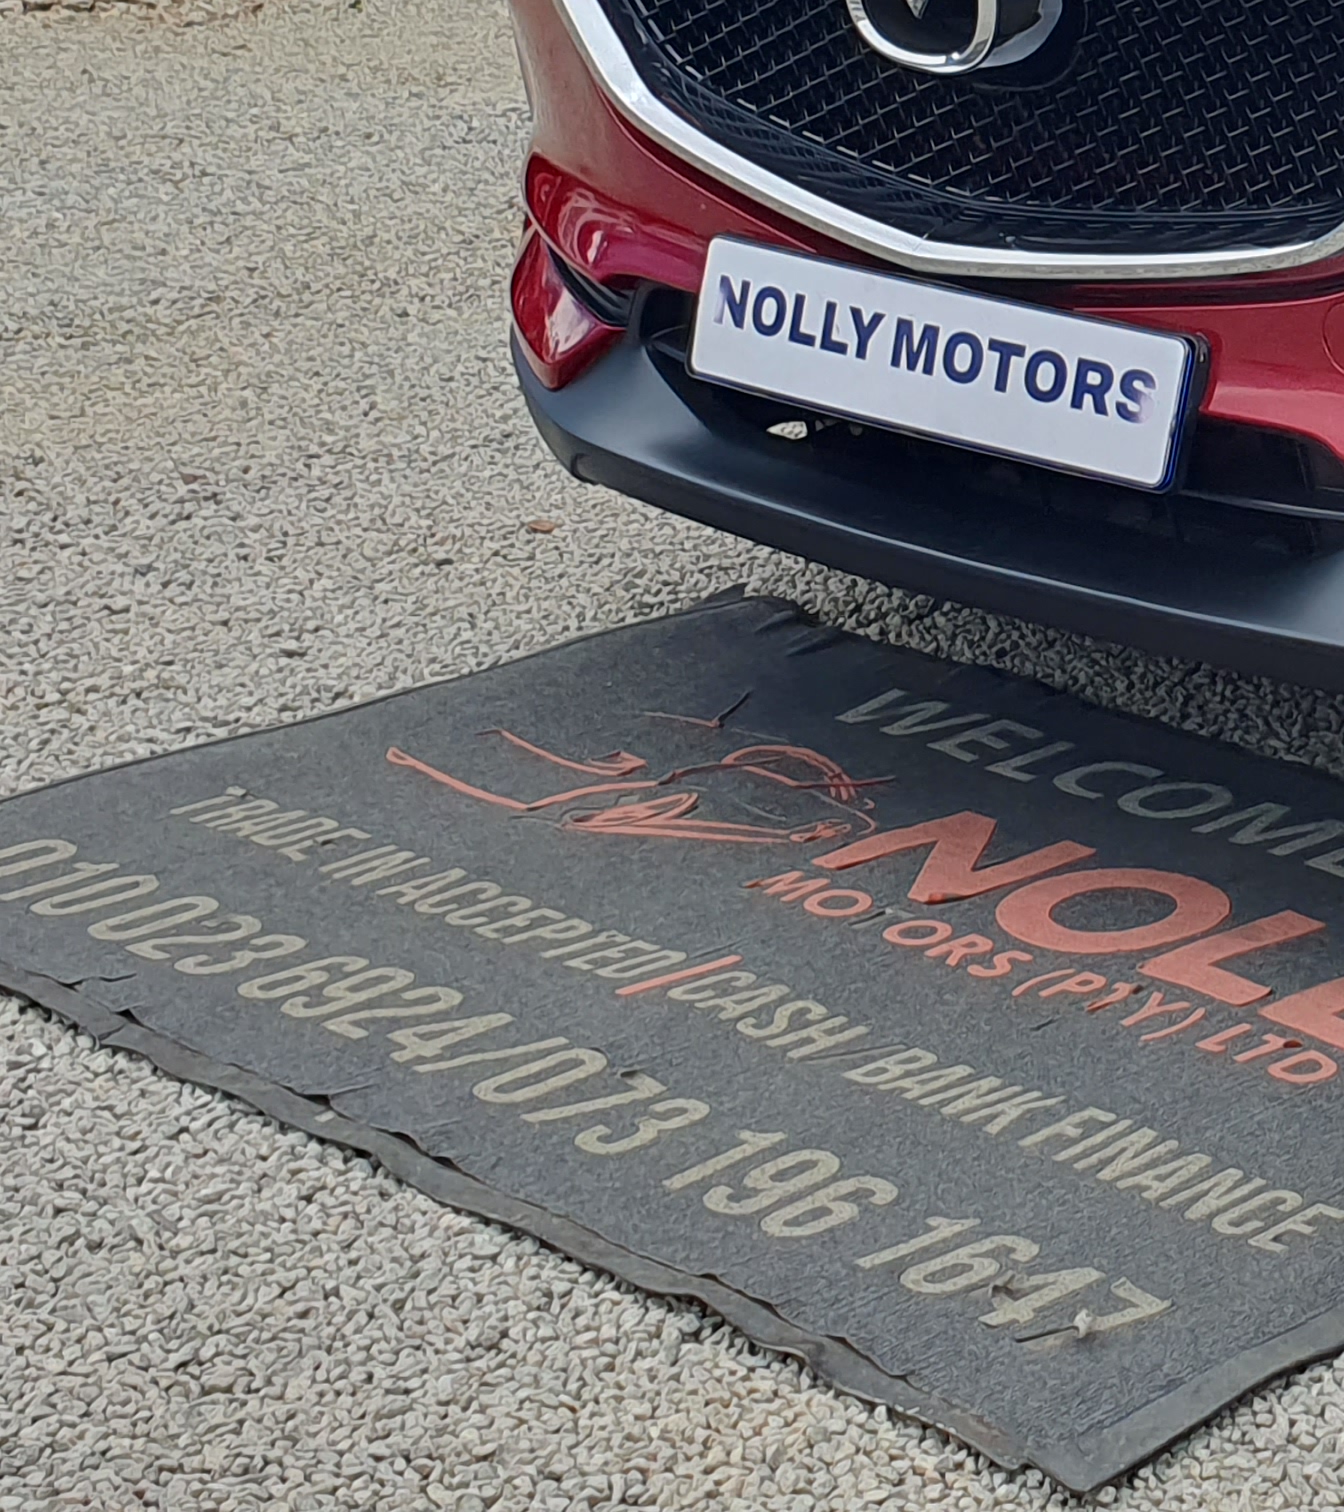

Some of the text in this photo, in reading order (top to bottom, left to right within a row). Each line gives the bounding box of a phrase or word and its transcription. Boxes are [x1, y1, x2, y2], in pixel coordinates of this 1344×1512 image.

[713, 274, 1157, 423] NOLLY MOTORS
[168, 790, 372, 862] TRADE
[319, 844, 431, 886] IN
[746, 870, 1339, 1085] MOTORS (PTY) LTD
[237, 955, 711, 1154] 6924/073
[662, 1128, 898, 1238] 196
[856, 1214, 1174, 1341] 1647
